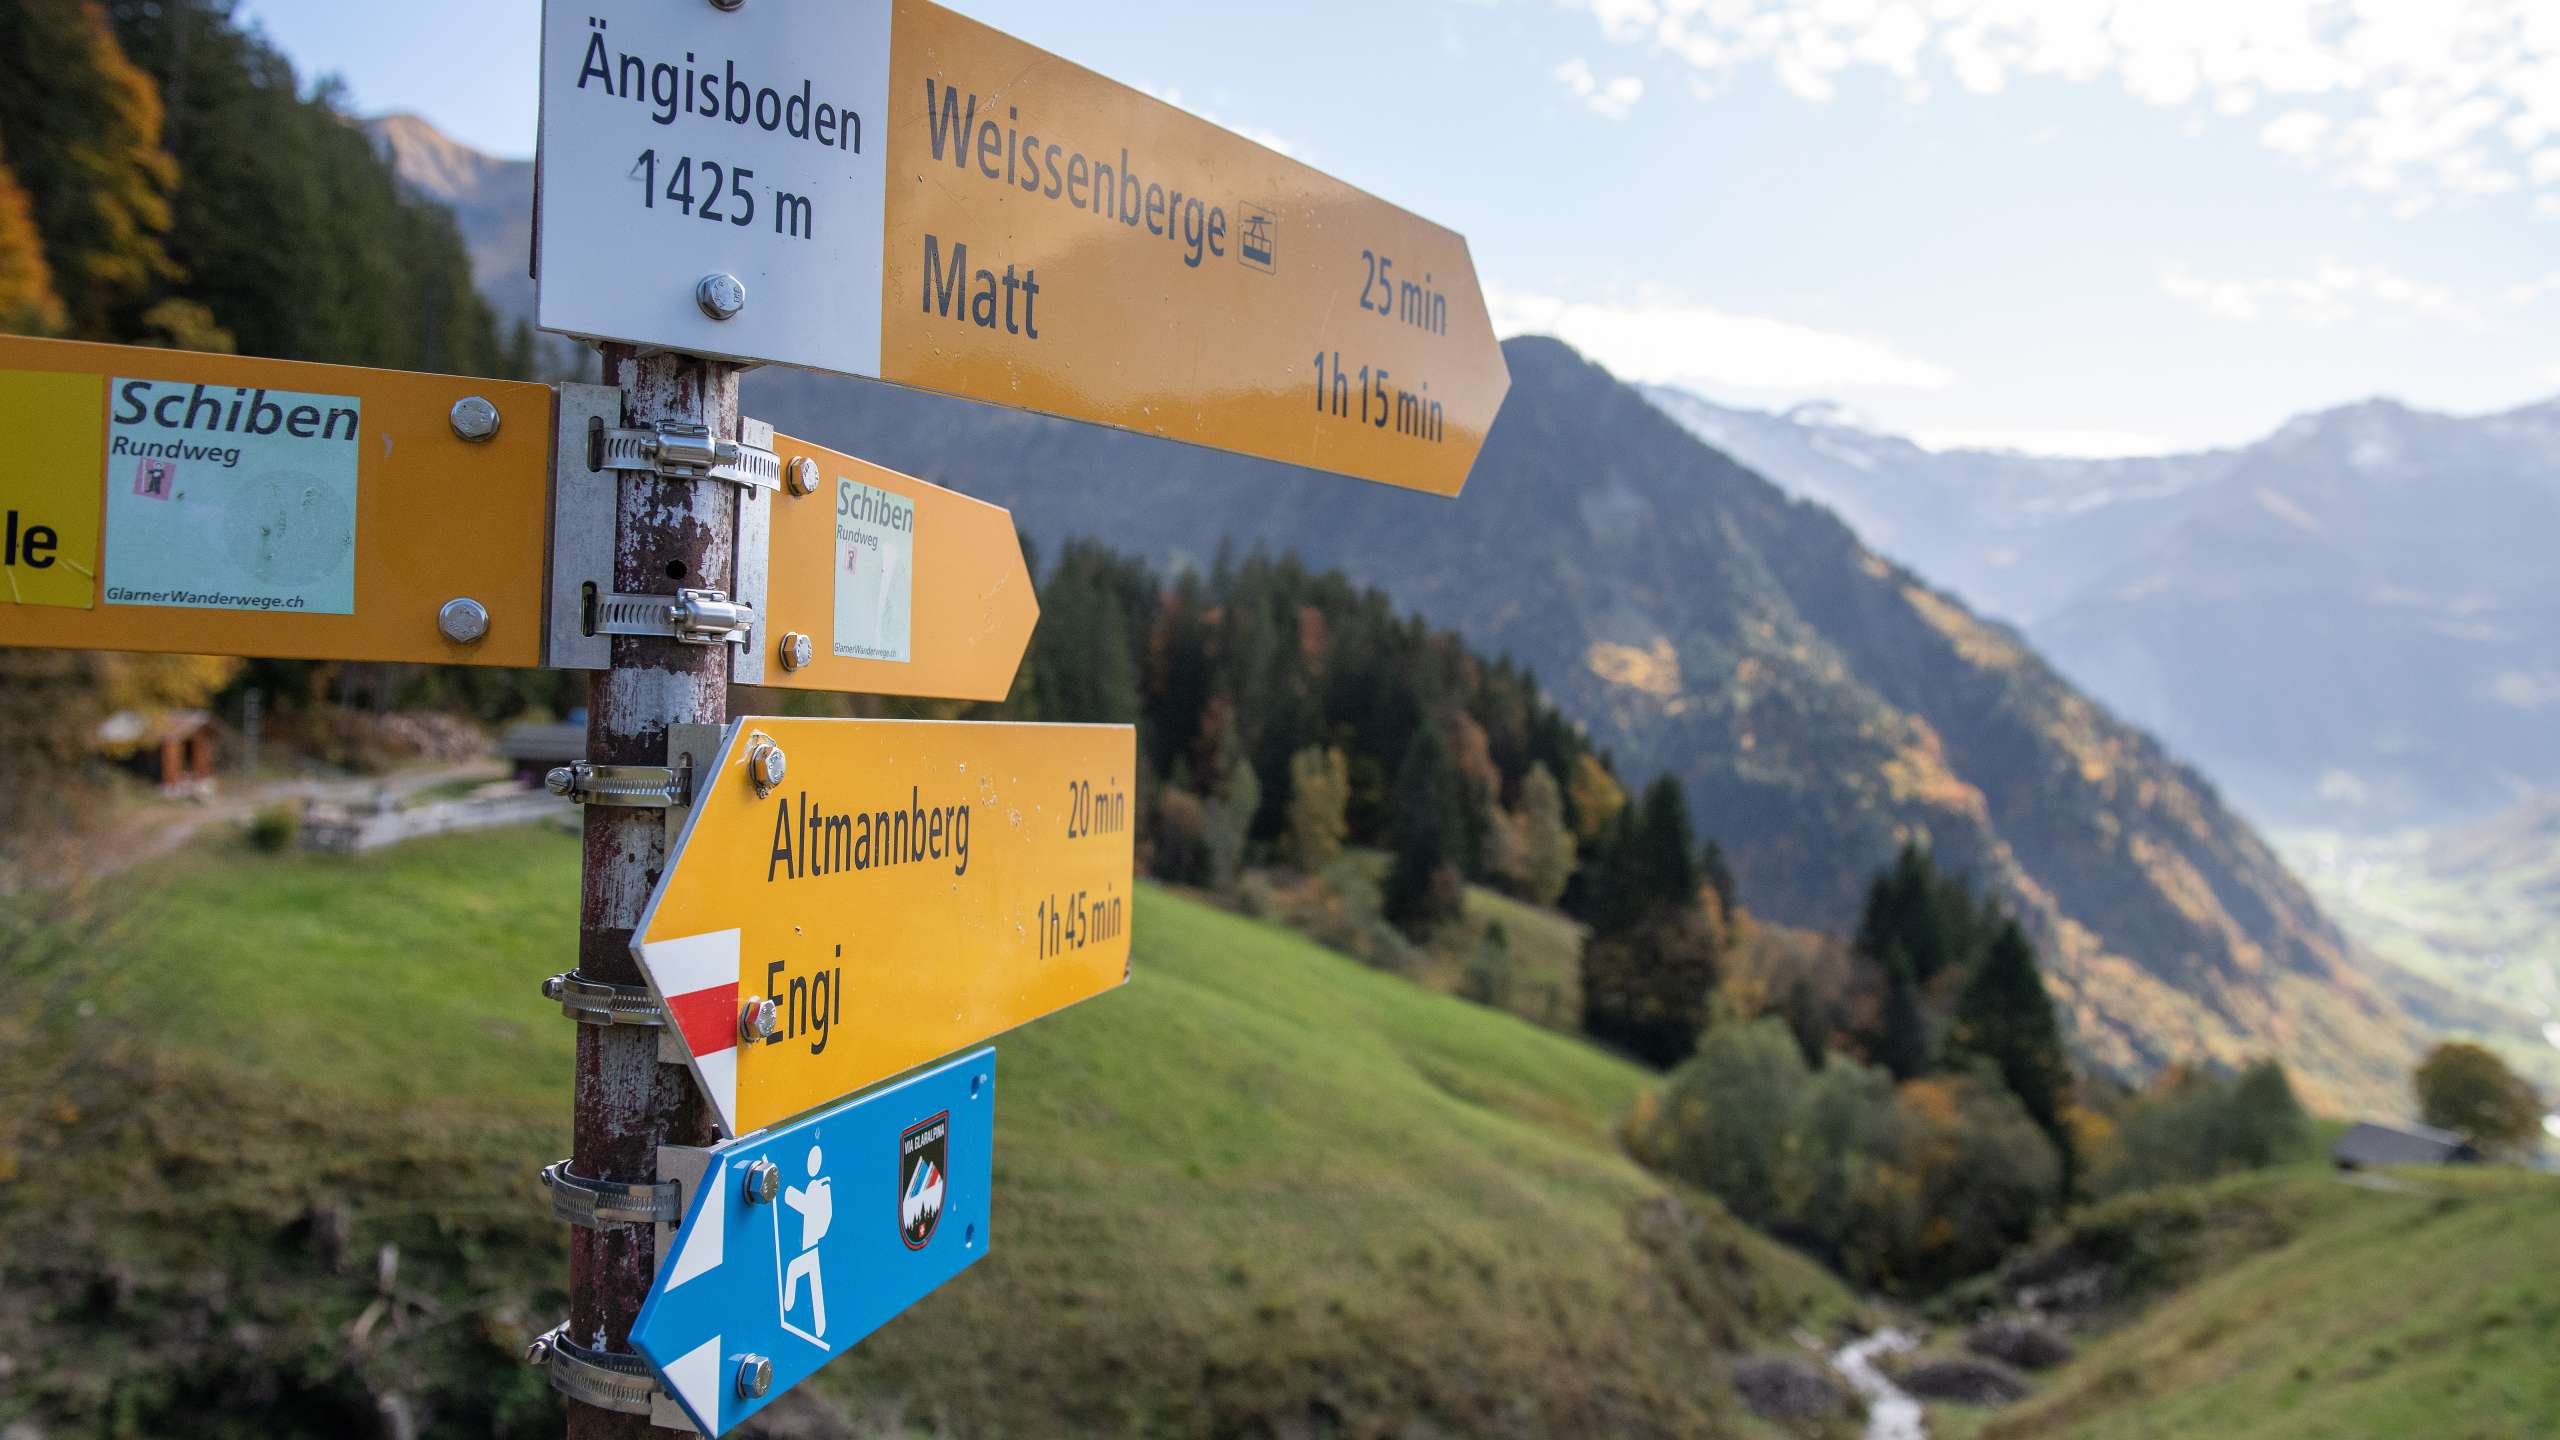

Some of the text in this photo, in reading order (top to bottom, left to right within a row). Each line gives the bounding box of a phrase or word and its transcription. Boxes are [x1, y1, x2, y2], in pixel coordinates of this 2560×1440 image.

[577, 16, 861, 154] Ängisboden
[638, 149, 812, 239] 1425 m
[926, 78, 1225, 268] Weissenberge
[922, 233, 1040, 340] Matt
[1360, 249, 1447, 336] 25 min
[113, 380, 359, 441] Schiben
[1358, 365, 1389, 428] 15
[1397, 382, 1443, 444] min
[111, 436, 241, 468] Rundweg
[836, 524, 878, 551] Rundweg
[837, 481, 912, 533] Schiben
[107, 587, 304, 610] GlarnerWanderwege.ch
[767, 785, 970, 882] Altmannberg
[1068, 776, 1124, 839] 20 min
[1065, 890, 1087, 950] 45
[1091, 881, 1121, 944] min
[766, 944, 842, 1055] Engi
[904, 1139, 914, 1155] VIA
